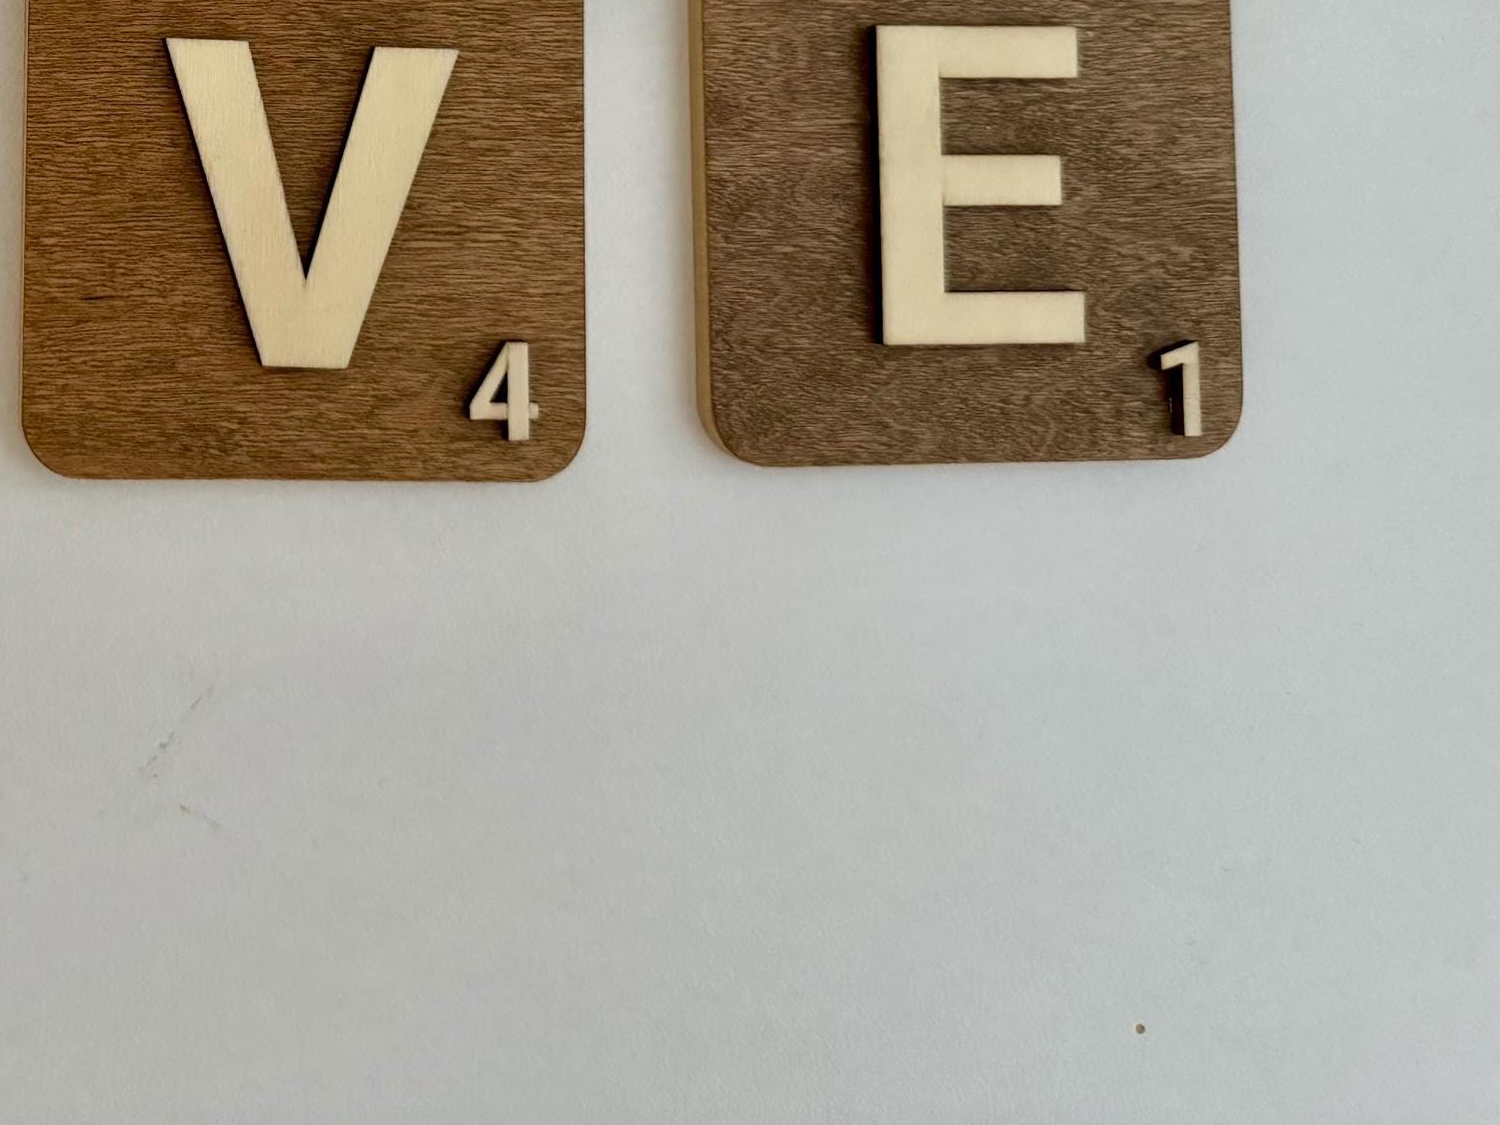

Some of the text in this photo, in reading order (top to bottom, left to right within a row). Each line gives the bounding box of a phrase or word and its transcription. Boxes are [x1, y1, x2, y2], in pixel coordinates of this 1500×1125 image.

[168, 38, 459, 369] V
[878, 26, 1087, 345] E
[469, 342, 541, 442] 4
[1160, 343, 1206, 439] 1
